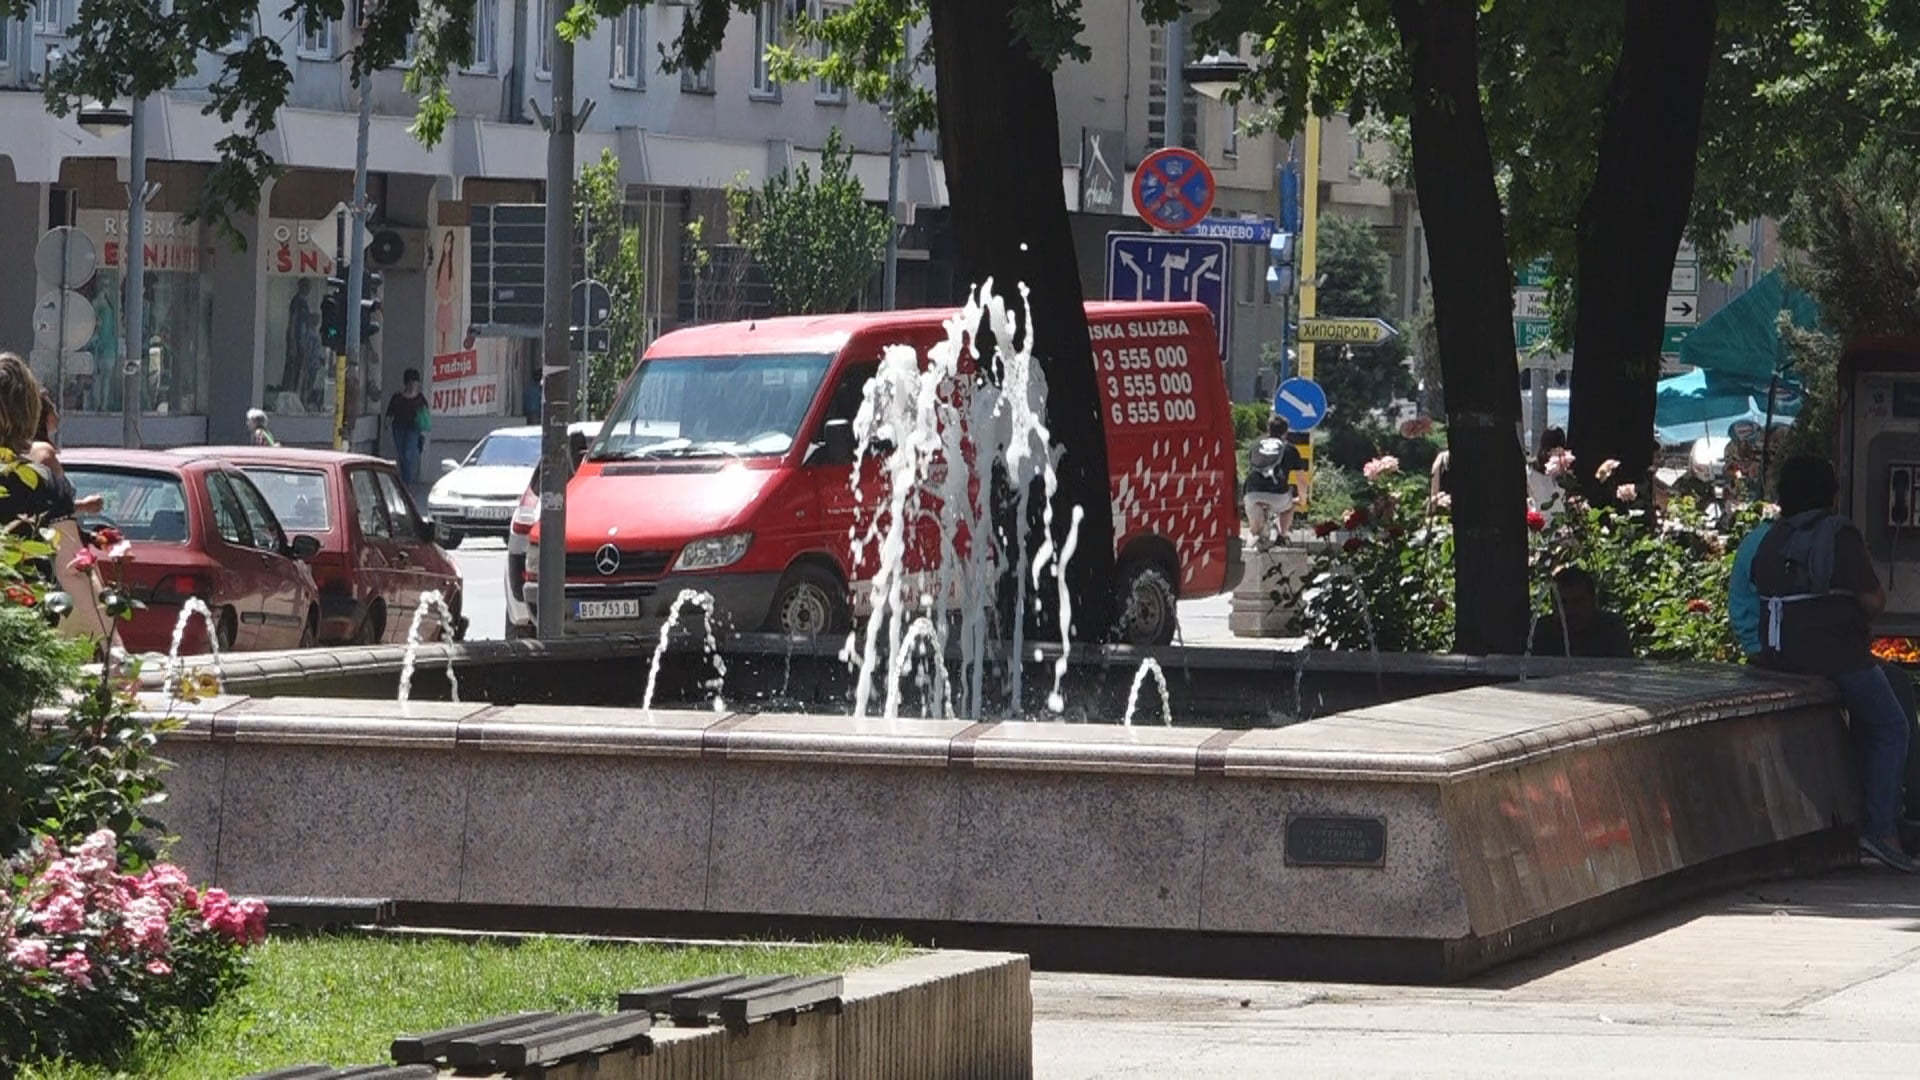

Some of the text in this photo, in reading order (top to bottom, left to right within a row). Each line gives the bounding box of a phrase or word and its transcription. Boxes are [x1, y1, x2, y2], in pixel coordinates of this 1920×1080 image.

[1210, 225, 1254, 240] КУЧЕВО
[1128, 318, 1189, 338] SLUŽBA
[1304, 323, 1370, 340] ХИПОДРОМ
[1102, 349, 1115, 371] 3
[1119, 347, 1152, 370] 555
[1155, 345, 1188, 369] 000
[1107, 371, 1193, 398] 3 555 000
[1111, 398, 1196, 424] 6 555 000
